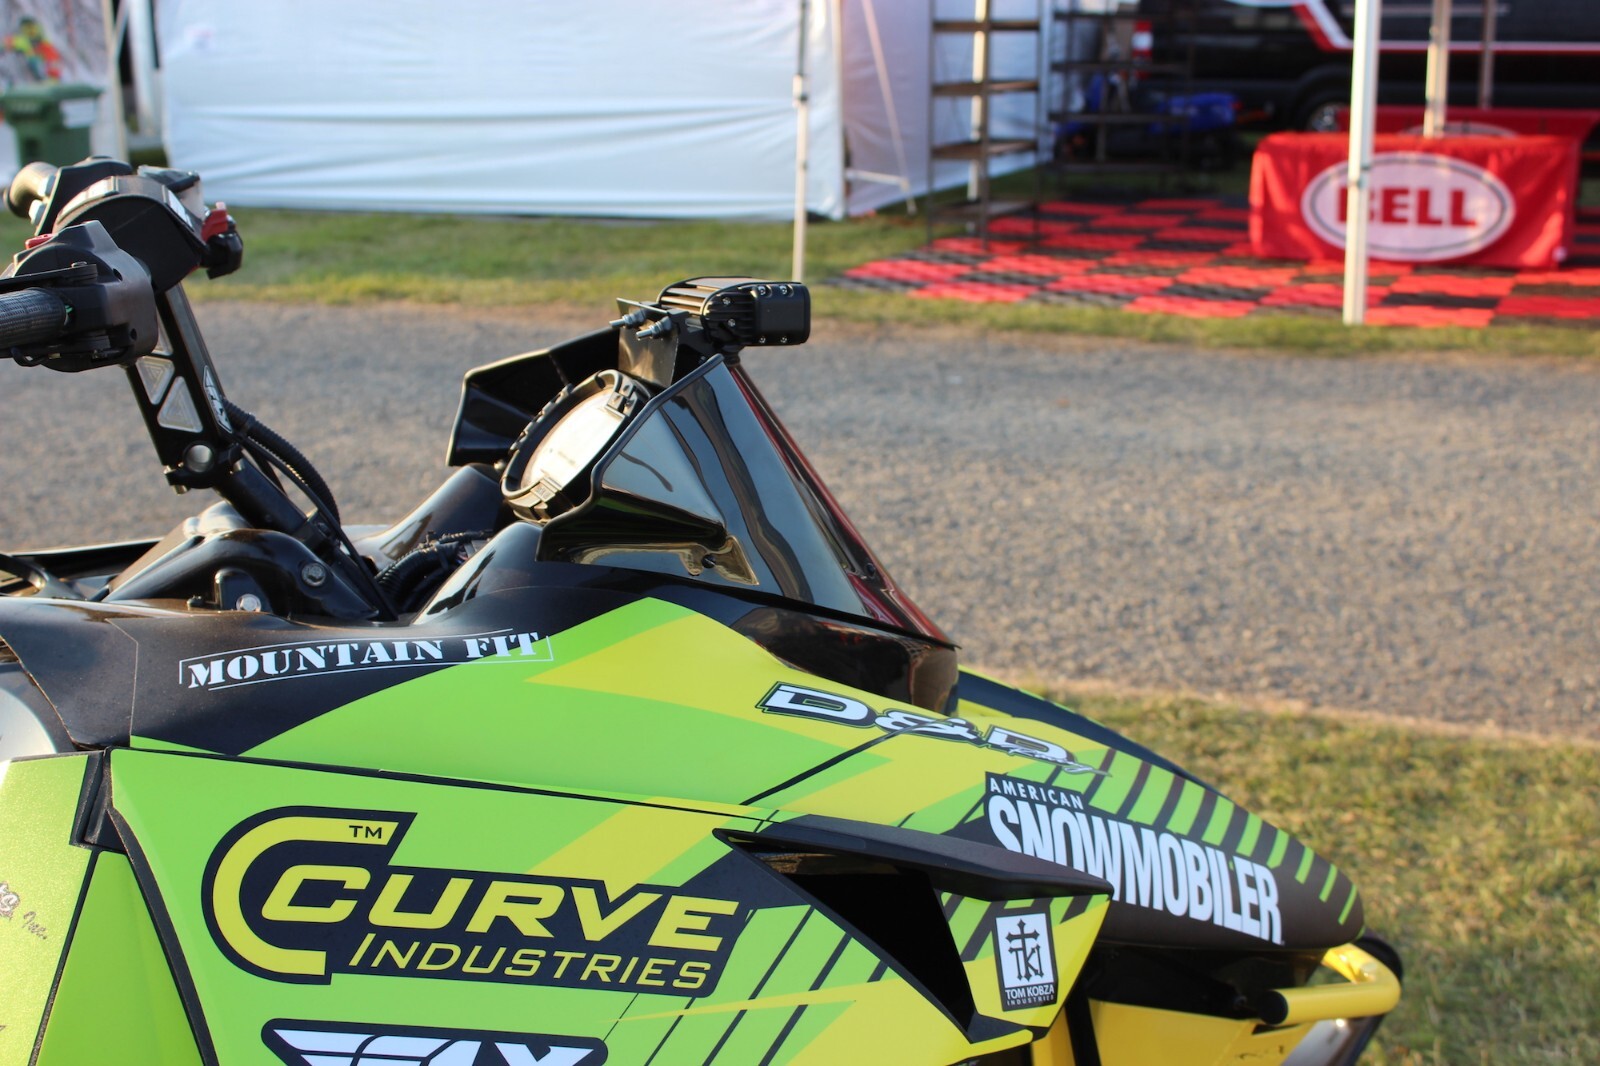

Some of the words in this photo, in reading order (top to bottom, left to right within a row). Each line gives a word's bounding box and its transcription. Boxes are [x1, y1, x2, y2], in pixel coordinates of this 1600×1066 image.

[188, 640, 443, 688] MOUNTAIN
[463, 632, 539, 658] FIT
[756, 682, 1077, 764] D&D
[989, 777, 1083, 810] AMERICAN
[988, 795, 1282, 945] SNOWMOBILER
[349, 933, 711, 989] INDUSTRIES
[1005, 988, 1026, 999] TOM
[1027, 984, 1055, 997] KOBZA
